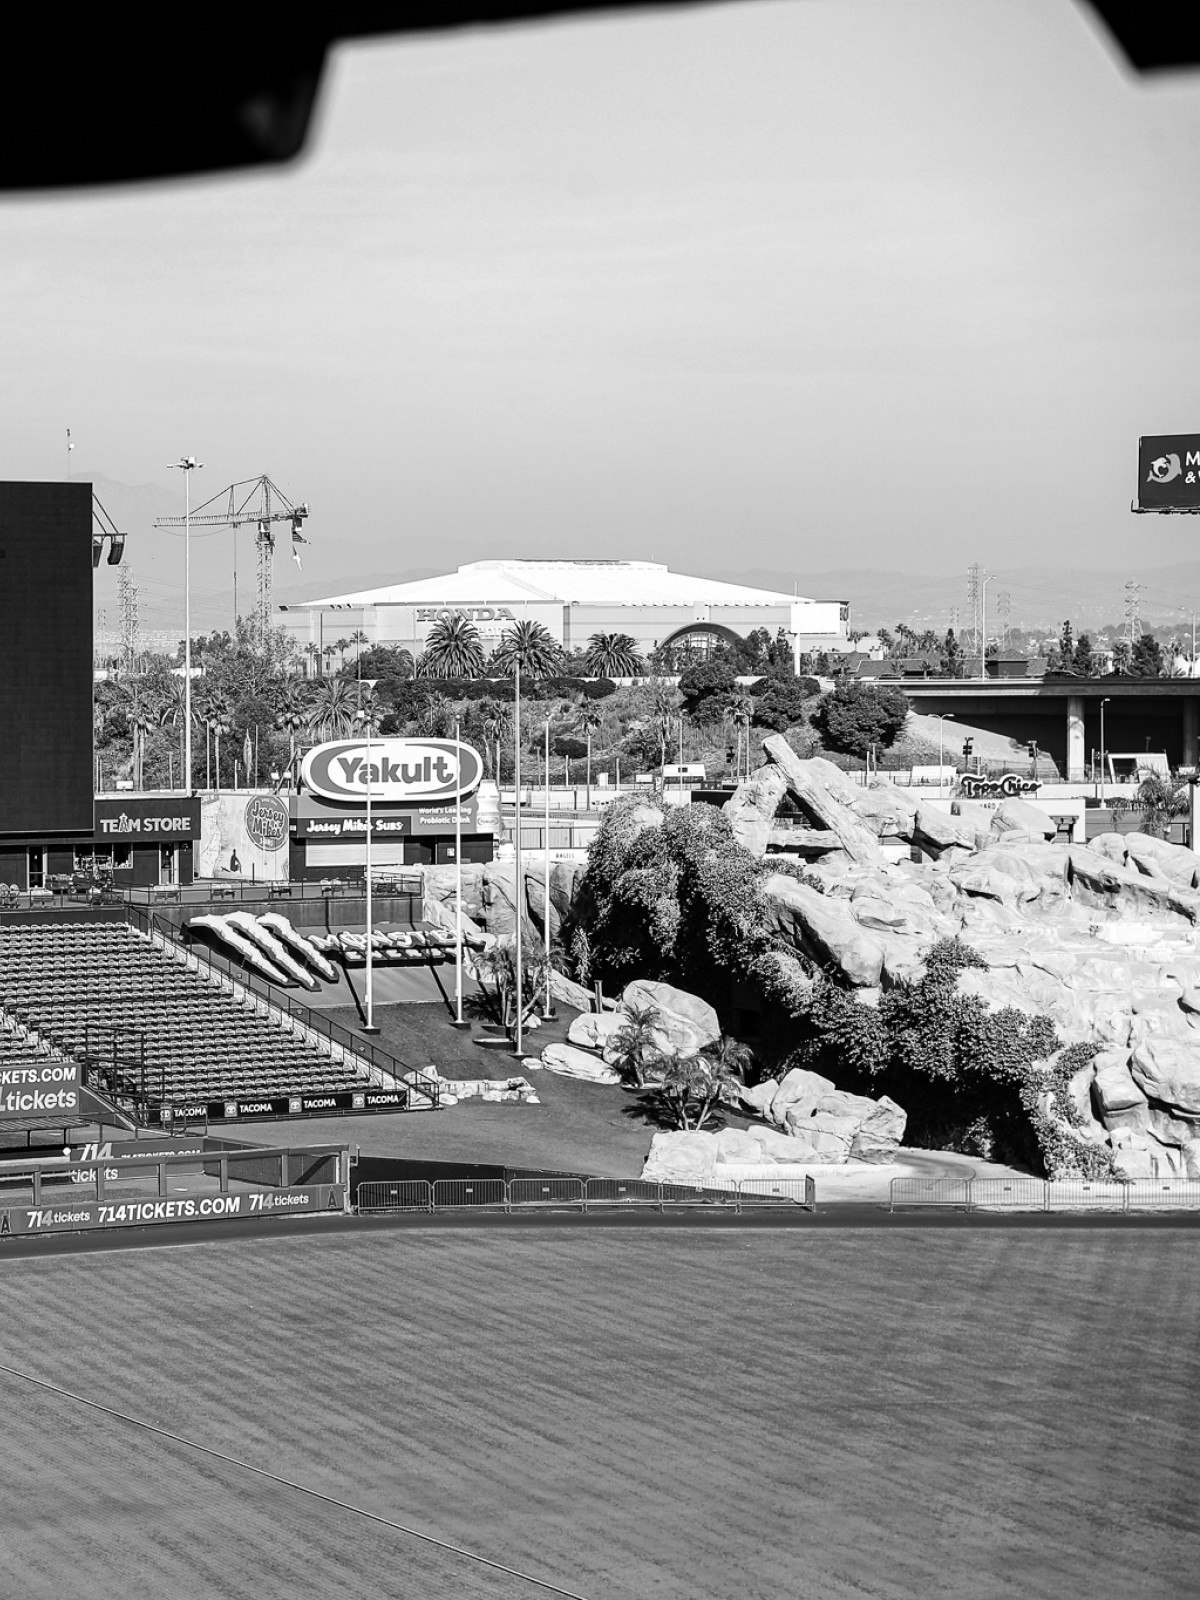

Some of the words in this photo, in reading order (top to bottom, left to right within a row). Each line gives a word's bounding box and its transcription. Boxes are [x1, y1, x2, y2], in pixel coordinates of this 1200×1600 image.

[416, 608, 516, 622] HONDA
[337, 756, 455, 785] Yakult
[960, 774, 1001, 797] Topo
[1001, 774, 1043, 797] Chico
[252, 801, 284, 822] Jersey
[445, 807, 471, 815] Leaing
[100, 813, 141, 833] TEAM
[143, 817, 191, 832] STORE
[306, 820, 341, 835] Jersey
[303, 1098, 336, 1108] TACOMA
[367, 1095, 399, 1104] TACOMA
[174, 1107, 207, 1117] TACOMA
[240, 1103, 273, 1113] TACOMA
[72, 1167, 119, 1183] tickts
[98, 1197, 240, 1224] 714TICKETS.COM
